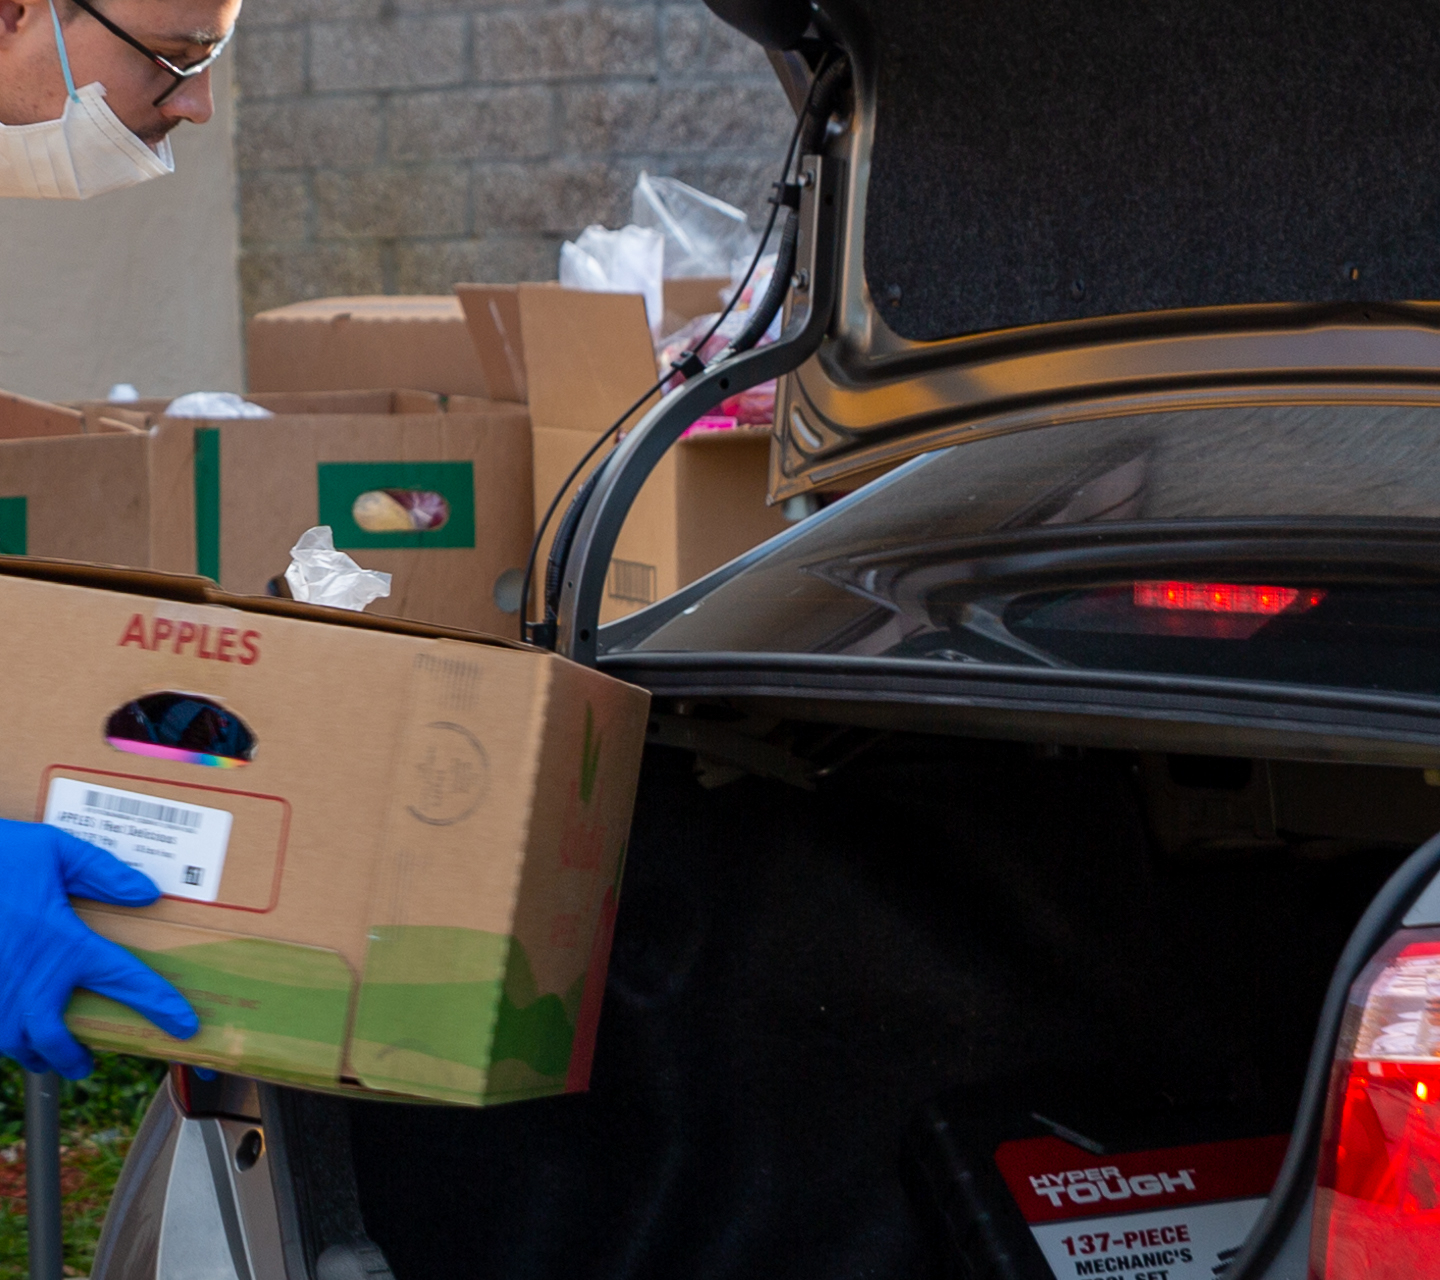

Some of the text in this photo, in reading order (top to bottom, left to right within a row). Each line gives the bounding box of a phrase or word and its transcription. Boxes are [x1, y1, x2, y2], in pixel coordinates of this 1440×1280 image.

[117, 613, 262, 666] APPLES
[1029, 1166, 1121, 1188] HYPER
[1035, 1169, 1196, 1207] TOUGH
[1062, 1224, 1191, 1257] 137-PIECE
[1075, 1248, 1193, 1276] MECHANIC'S
